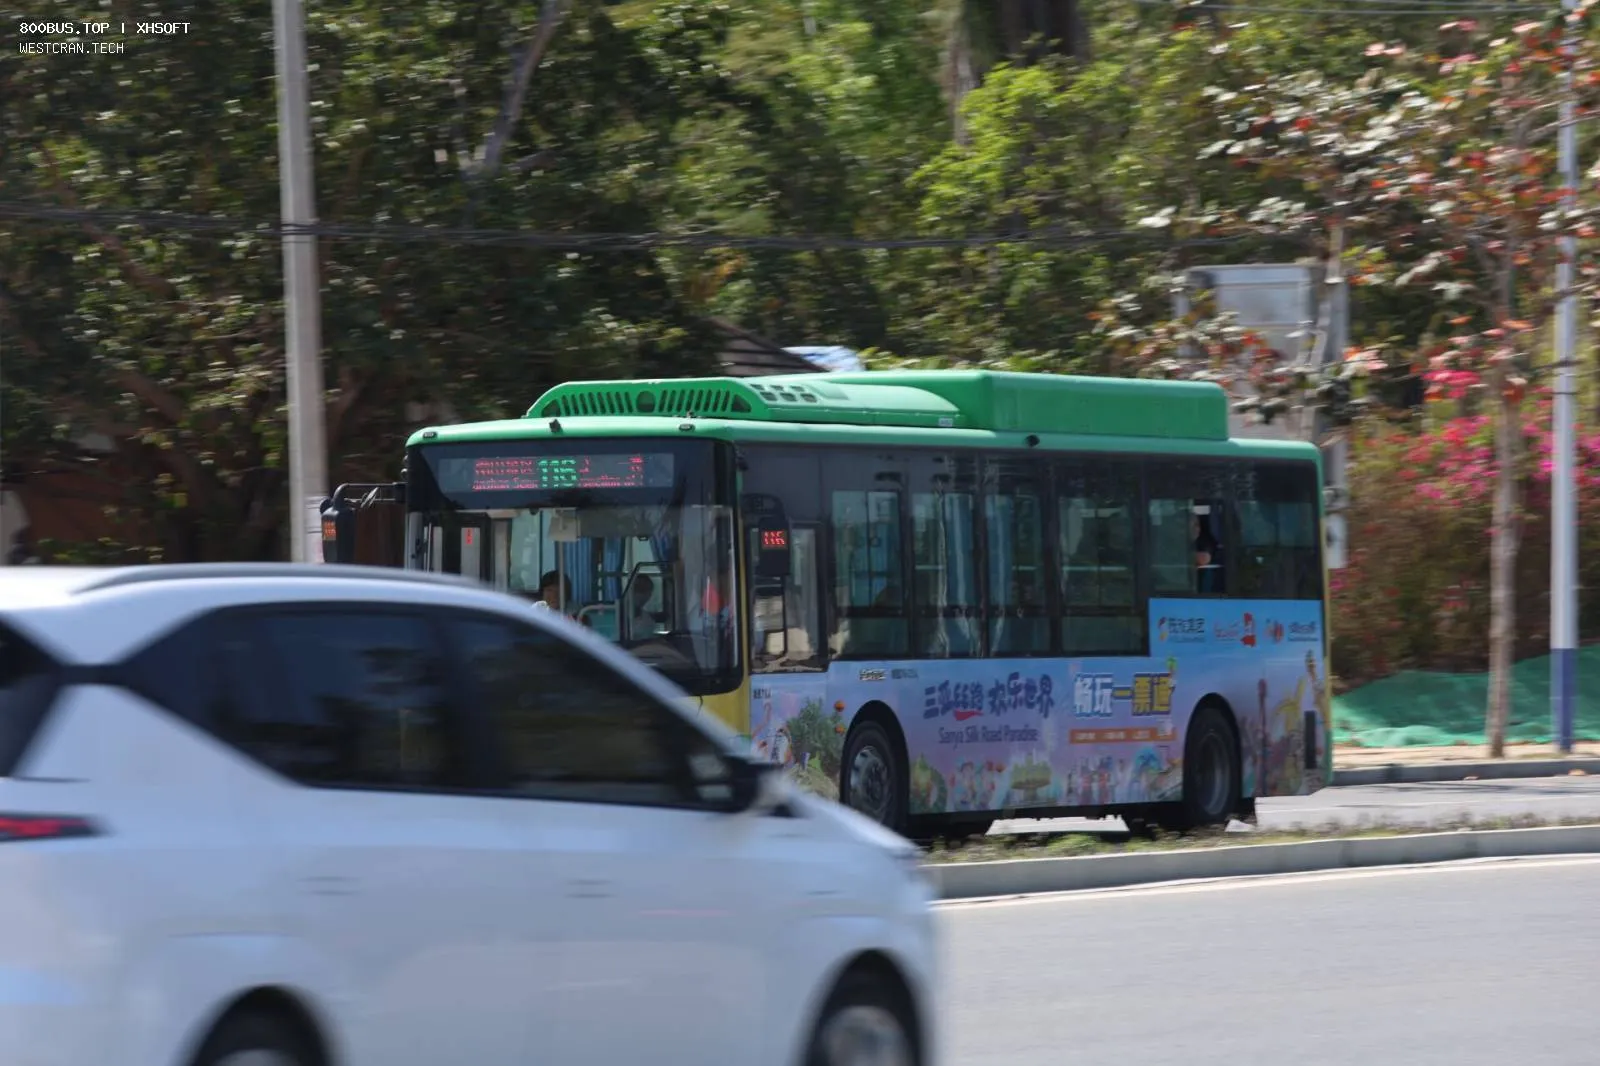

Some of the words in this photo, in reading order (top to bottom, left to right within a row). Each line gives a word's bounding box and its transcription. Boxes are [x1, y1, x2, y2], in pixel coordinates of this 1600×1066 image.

[537, 457, 577, 488] 116
[763, 530, 785, 545] 116
[938, 726, 964, 750] Sanya
[965, 724, 980, 743] Silk
[981, 724, 1002, 743] Road
[1003, 724, 1039, 742] Paradise
